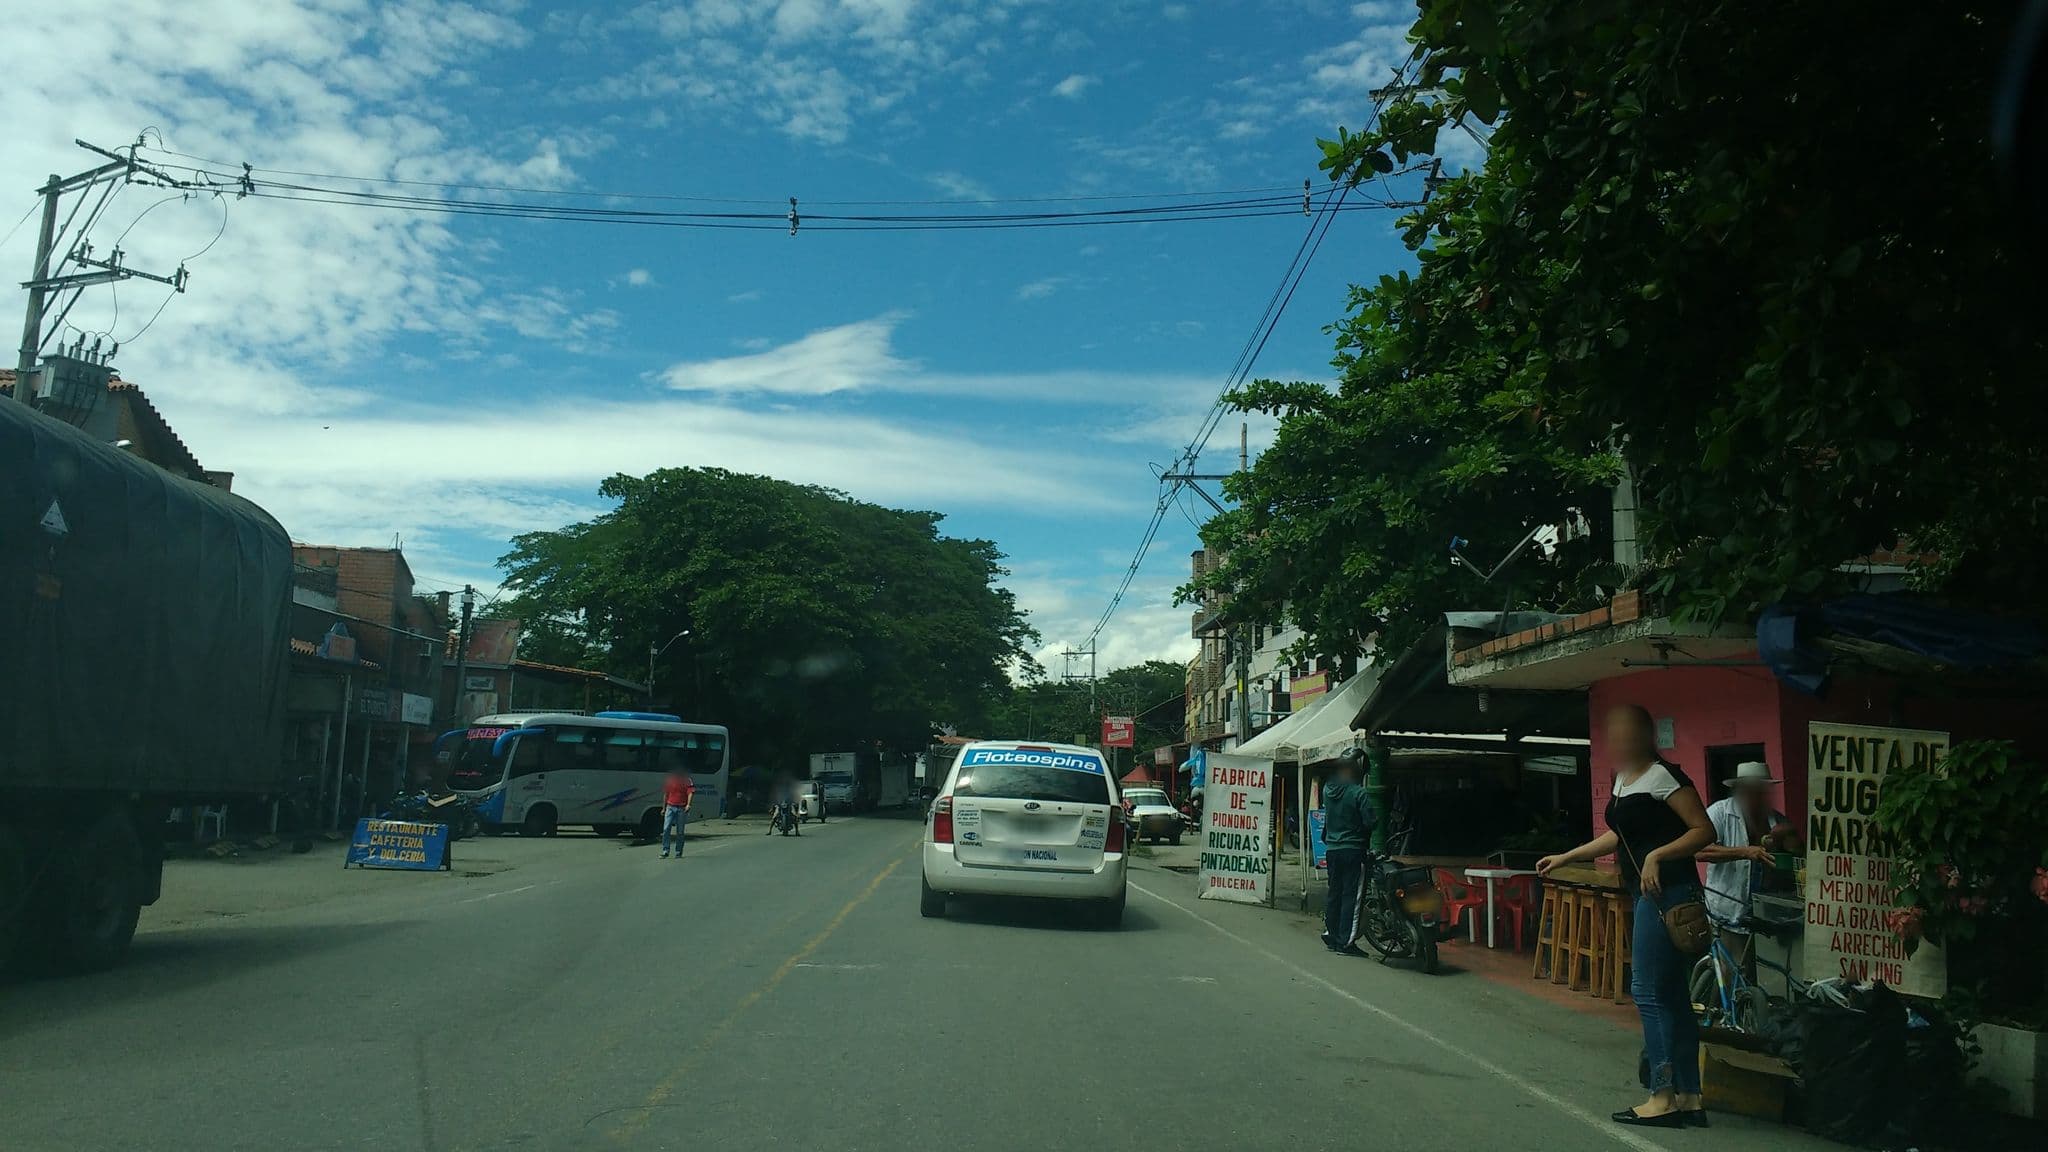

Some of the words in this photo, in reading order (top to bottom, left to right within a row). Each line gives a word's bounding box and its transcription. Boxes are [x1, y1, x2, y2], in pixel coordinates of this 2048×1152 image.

[972, 751, 1097, 770] Flotaospina
[1810, 734, 1903, 775] VENTA
[1913, 741, 1945, 776] DE
[1212, 767, 1267, 788] FABRICA
[1230, 791, 1248, 810] DE
[1814, 777, 1887, 815] JUG
[367, 820, 439, 836] RESTAURANTE
[1212, 812, 1259, 830] PIONONOS
[370, 834, 424, 848] CAFETERIA
[1208, 831, 1260, 852] RICURAS
[1809, 815, 1903, 858] NARAN
[368, 847, 376, 858] Y
[380, 848, 426, 863] DULCERIA
[1031, 849, 1058, 861] NACIONAL
[1200, 851, 1269, 874] PINTADEÑAS
[1826, 855, 1857, 877] CON:
[1210, 876, 1256, 890] DULCERIA
[1819, 879, 1864, 903] MERO
[1807, 902, 1847, 928] COLA
[1839, 957, 1868, 985] SAN
